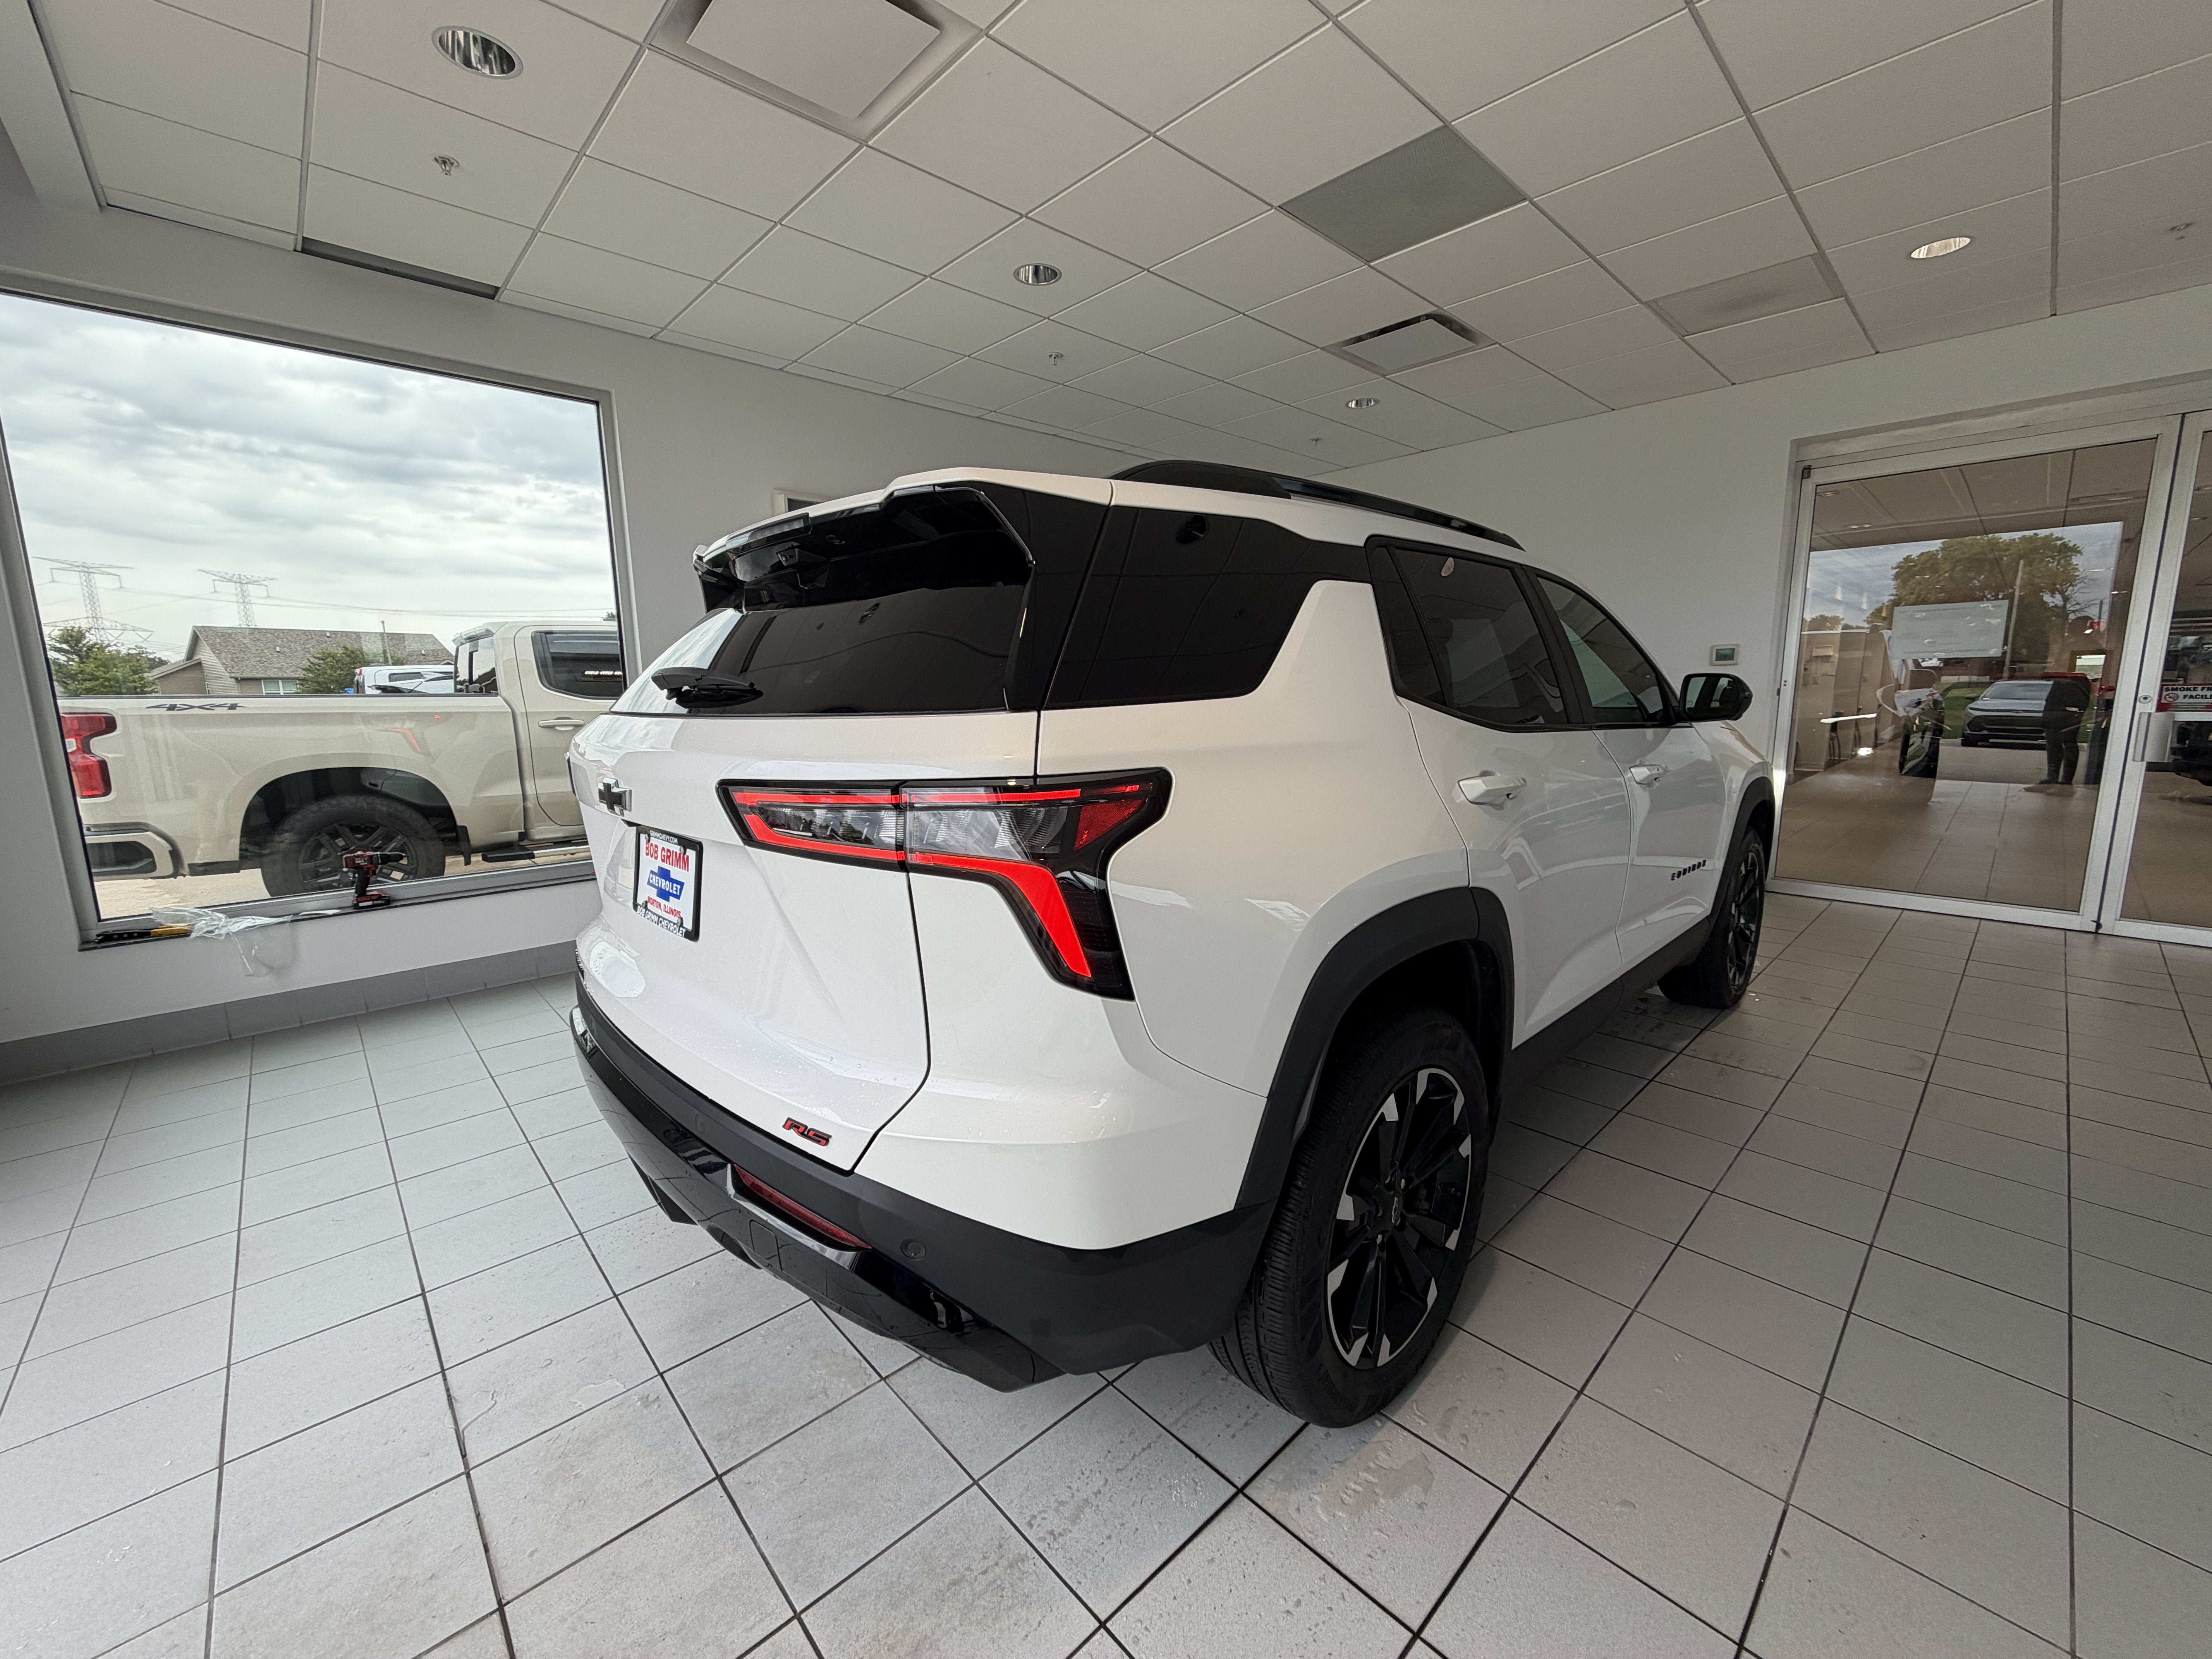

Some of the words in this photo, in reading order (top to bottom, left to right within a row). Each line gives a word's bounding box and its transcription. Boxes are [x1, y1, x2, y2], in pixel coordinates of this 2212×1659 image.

[646, 840, 658, 860] BOB
[661, 847, 689, 872] GRIMM
[649, 873, 680, 895] CHEVROLET
[637, 905, 646, 917] BOB
[645, 910, 658, 925] GRIMM
[659, 917, 685, 938] CHEVROLET
[647, 896, 662, 912] MORTON,
[663, 904, 681, 919] ILLINOIS
[782, 1117, 832, 1147] RS
